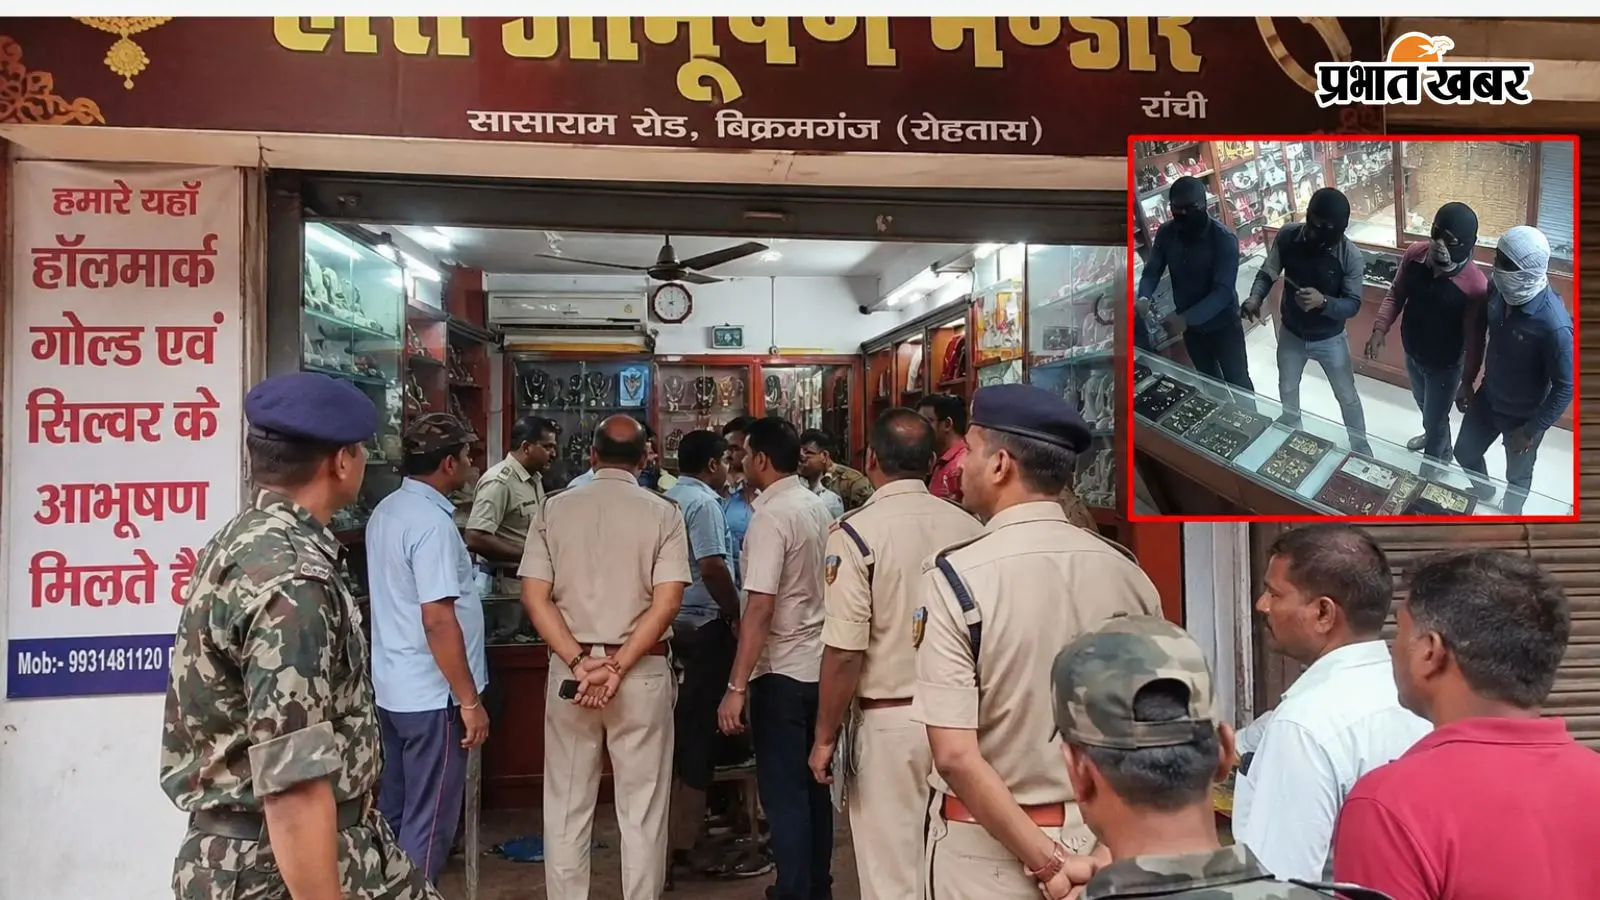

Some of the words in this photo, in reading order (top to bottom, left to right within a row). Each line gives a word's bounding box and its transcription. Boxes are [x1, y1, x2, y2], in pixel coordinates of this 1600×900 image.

[466, 110, 618, 136] सासाराम
[631, 108, 699, 141] रोड,
[715, 109, 881, 142] बिक्रमगंज
[896, 112, 1042, 146] (रोहतास)
[1140, 91, 1208, 119] रांची
[52, 179, 133, 216] हमारे
[31, 233, 218, 289] हॉलमार्क
[29, 311, 145, 366] गोल्ड
[155, 311, 225, 366] एवं
[26, 387, 164, 444] सिल्वर
[173, 386, 220, 441] के
[34, 481, 209, 539] आभूषण
[29, 549, 158, 608] मिलते
[18, 651, 64, 675] Mob:-
[68, 647, 162, 673] 9931481120
